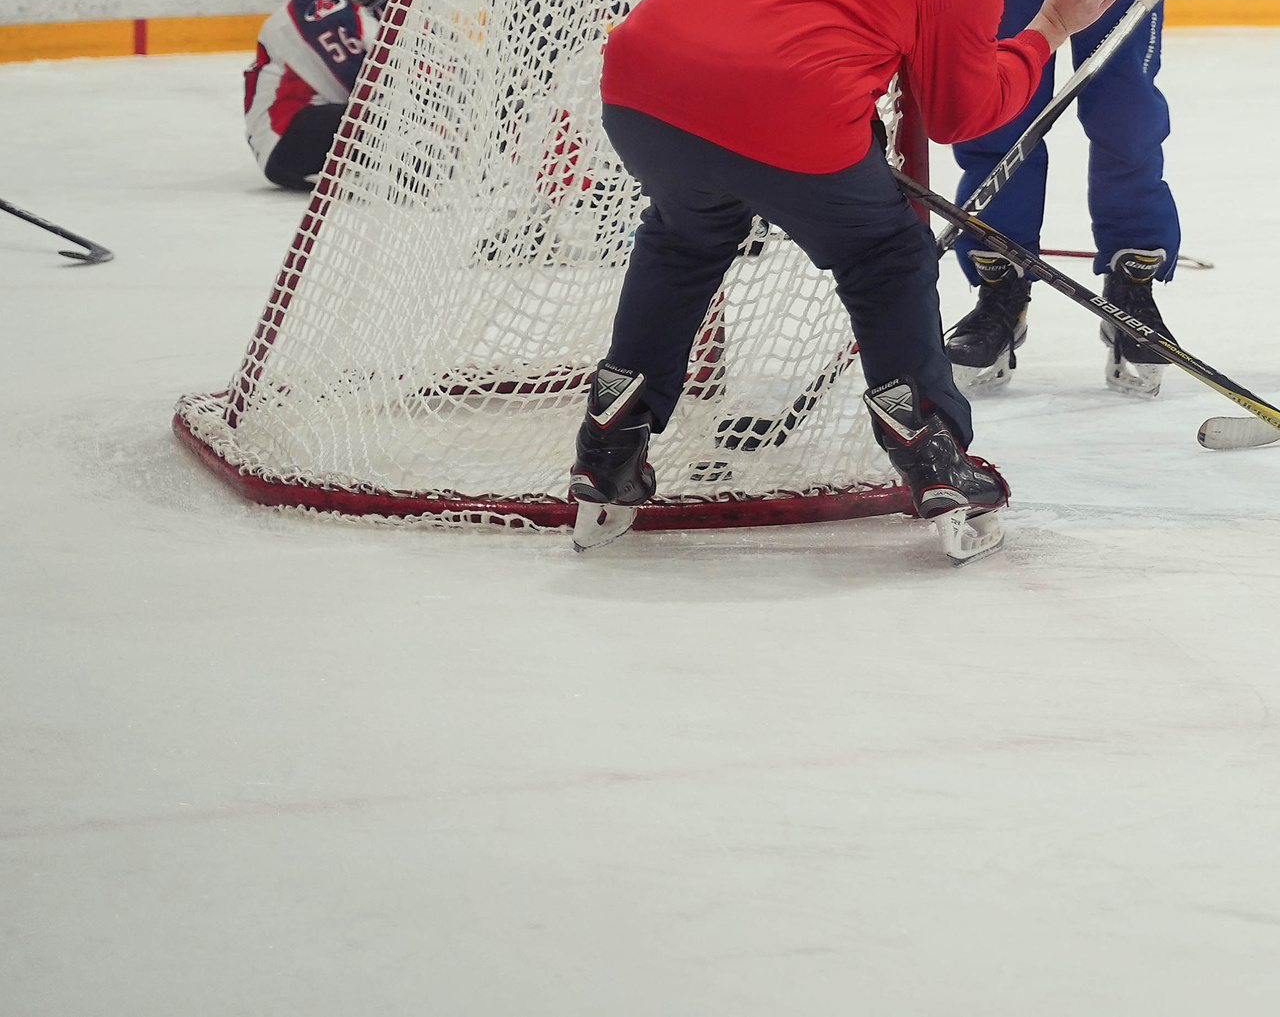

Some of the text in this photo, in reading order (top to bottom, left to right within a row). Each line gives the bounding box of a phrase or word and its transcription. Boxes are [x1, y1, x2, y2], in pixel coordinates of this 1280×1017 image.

[317, 26, 363, 64] 56
[1090, 295, 1154, 336] BAUER
[604, 362, 634, 375] BAUER
[871, 378, 899, 395] BAUER
